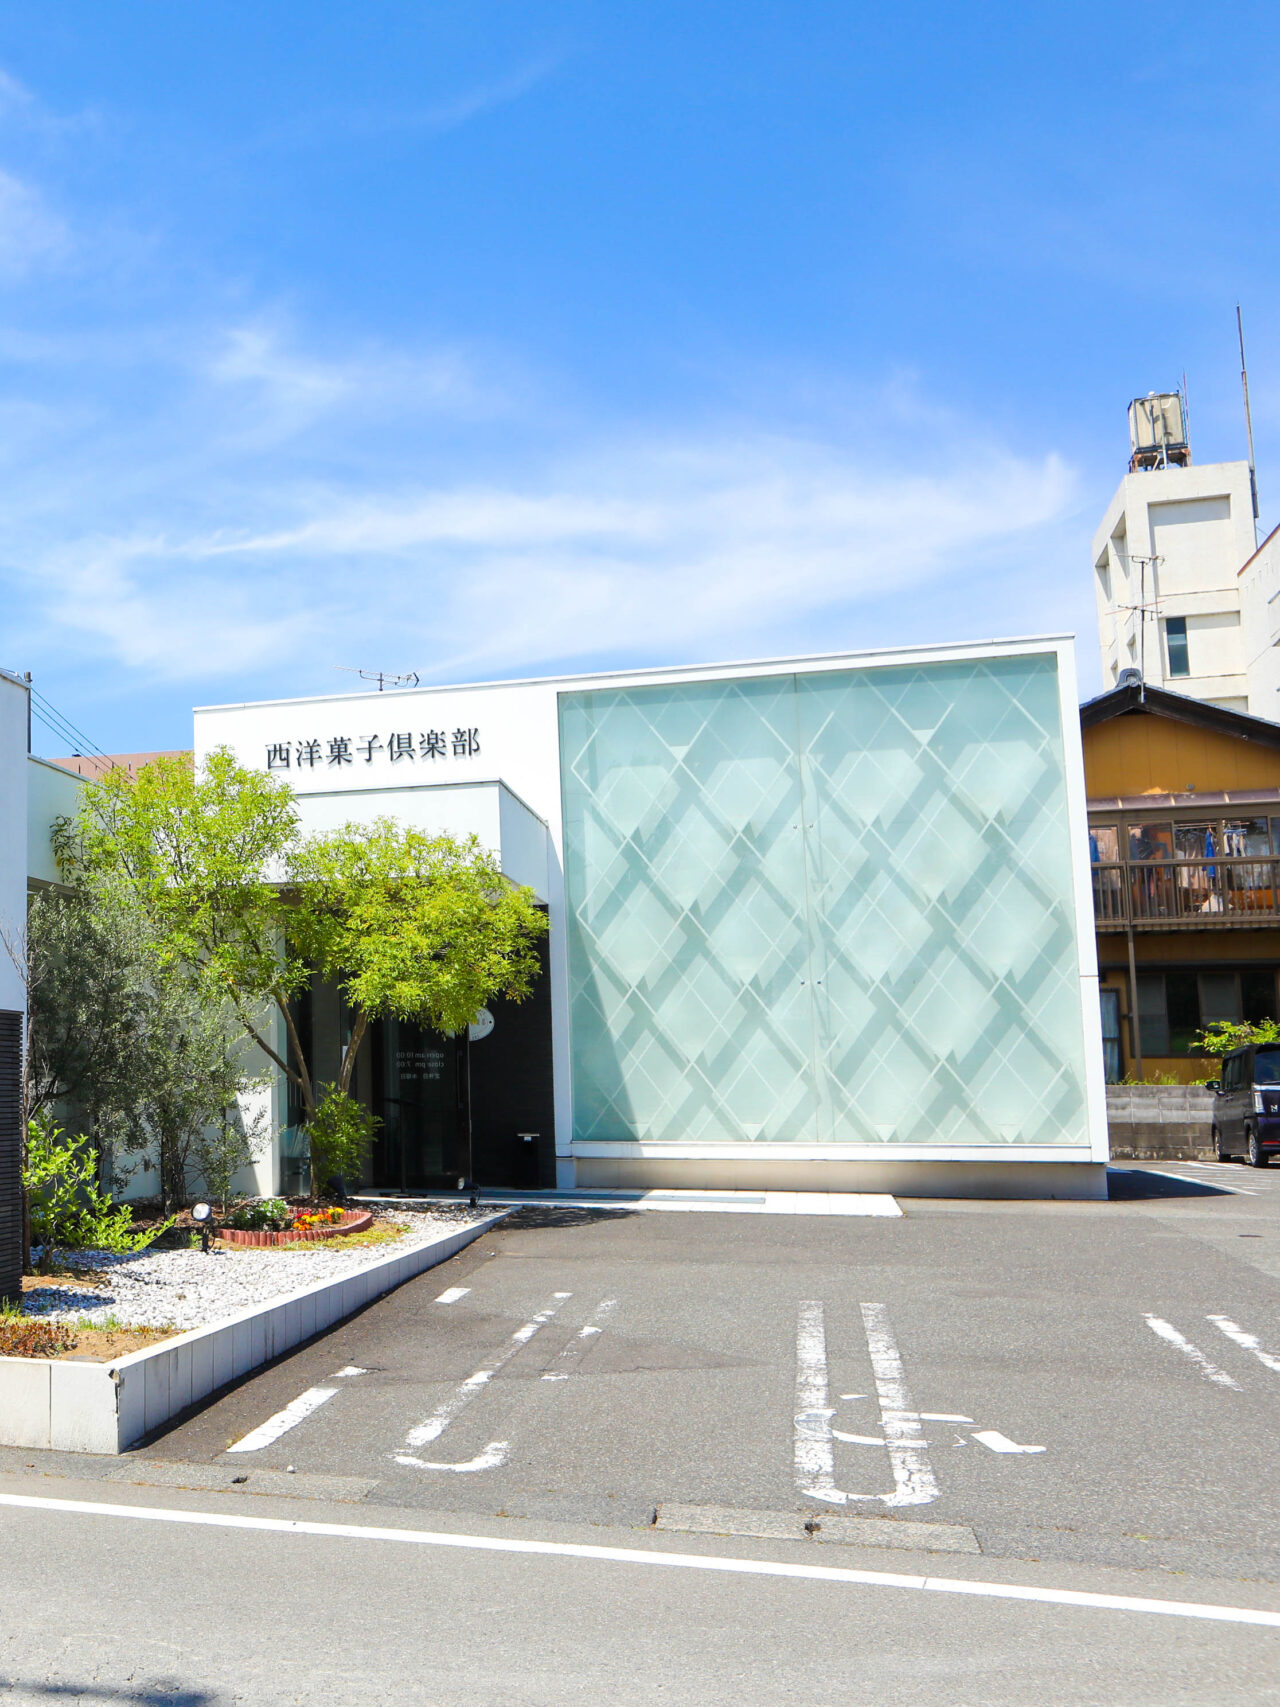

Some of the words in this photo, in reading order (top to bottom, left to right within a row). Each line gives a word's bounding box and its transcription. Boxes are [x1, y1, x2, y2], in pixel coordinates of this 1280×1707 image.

[265, 727, 481, 770] 西洋菓子倶楽部
